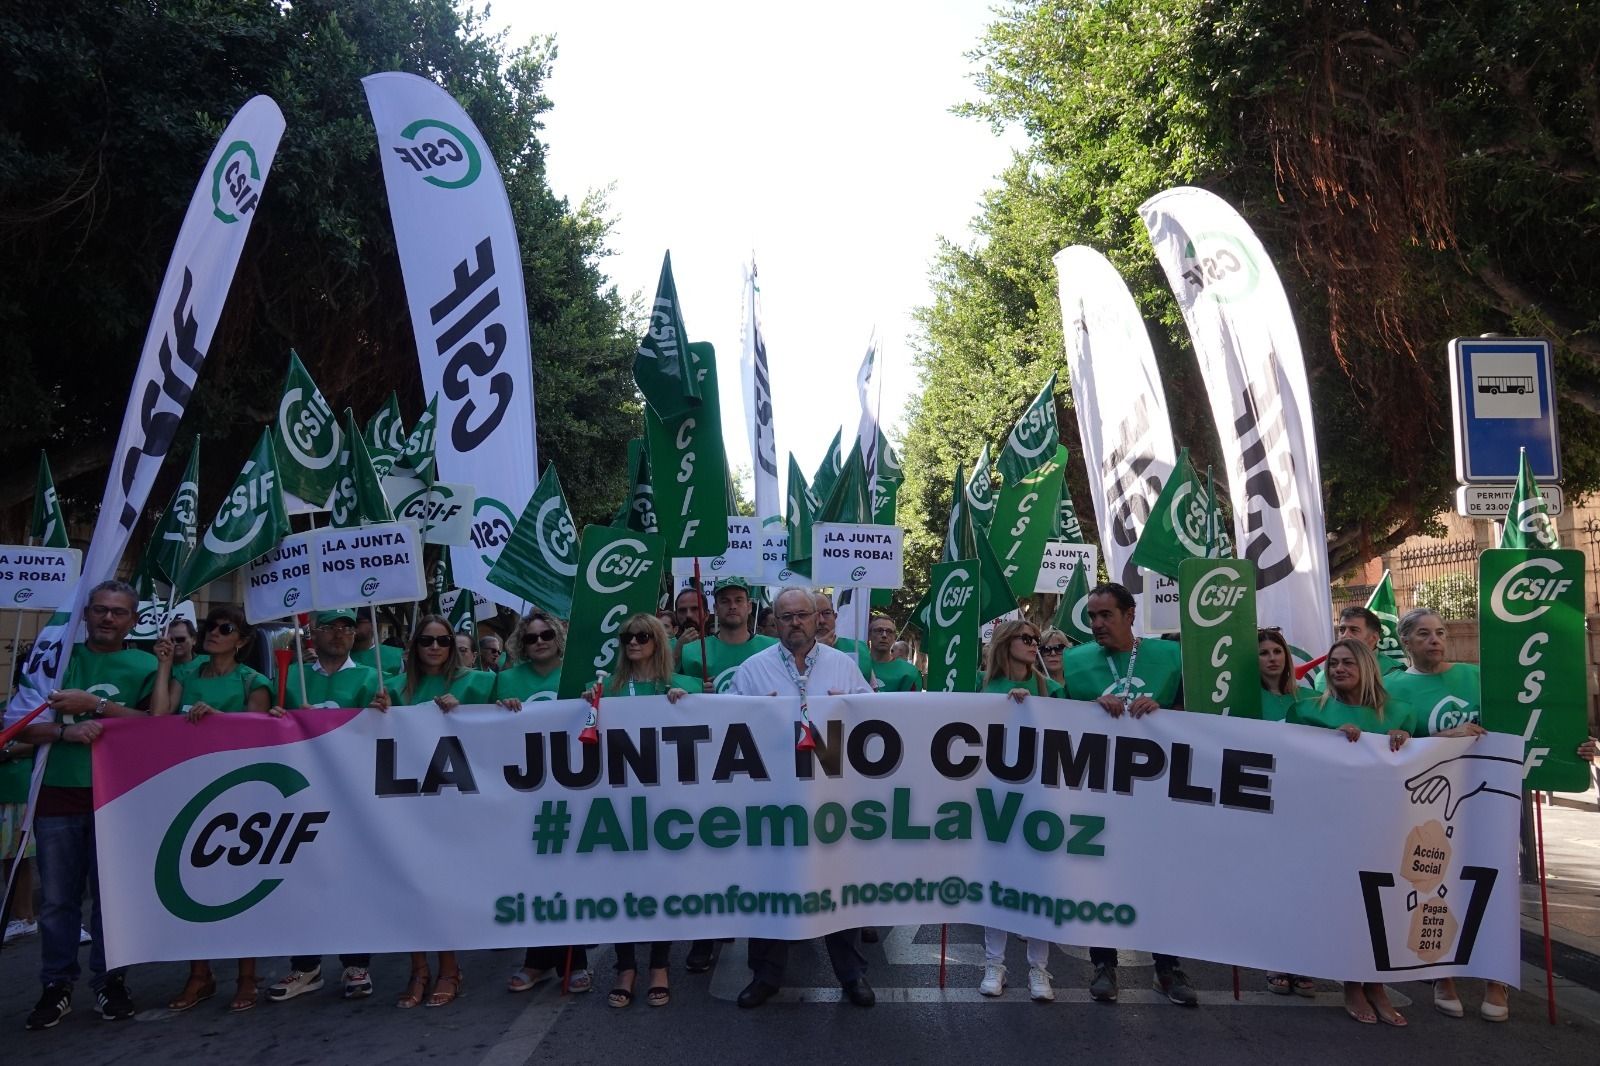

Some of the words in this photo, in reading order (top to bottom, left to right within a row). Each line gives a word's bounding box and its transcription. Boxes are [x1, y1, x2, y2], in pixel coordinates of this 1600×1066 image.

[225, 160, 258, 214] CSIF
[294, 388, 330, 449] CSIF
[1019, 400, 1055, 440] CSIF
[676, 418, 700, 550] CSIF
[215, 470, 274, 527] CSIF
[351, 533, 405, 549] JUNTA
[849, 534, 891, 544] JUNTA
[14, 555, 65, 565] JUNTA
[275, 543, 308, 561] JUNT
[823, 549, 849, 558] NOS
[854, 549, 893, 560] ROBA!
[1056, 549, 1090, 559] JUNTA
[323, 558, 355, 572] NOS
[360, 553, 409, 568] ROBA!
[601, 554, 653, 577] CSIF
[19, 571, 66, 581] ROBA!
[251, 571, 279, 587] NOS
[282, 563, 310, 580] ROB
[943, 586, 974, 607] CSIF
[1155, 593, 1179, 604] NOS
[1200, 585, 1247, 607] CSIF
[1507, 578, 1573, 600] CSIF
[1518, 632, 1550, 779] CSIF
[375, 735, 480, 797] LA
[503, 722, 770, 792] JUNTA
[794, 719, 904, 780] NO
[930, 721, 1275, 813] CUMPLE
[532, 787, 1106, 857] #AlcemosLaVoz
[190, 811, 330, 868] CSIF
[1413, 845, 1445, 860] Acción
[1412, 860, 1441, 874] Social
[493, 892, 525, 923] Si
[532, 892, 567, 921] tú
[575, 895, 618, 920] no
[623, 892, 658, 918] te
[663, 885, 837, 917] conformas,
[841, 876, 983, 906] nosotr@s
[989, 880, 1136, 926] tampoco
[1422, 904, 1447, 914] Pagas
[1422, 916, 1444, 926] Extra
[1421, 928, 1442, 938] 2013
[1419, 940, 1441, 950] 2014
